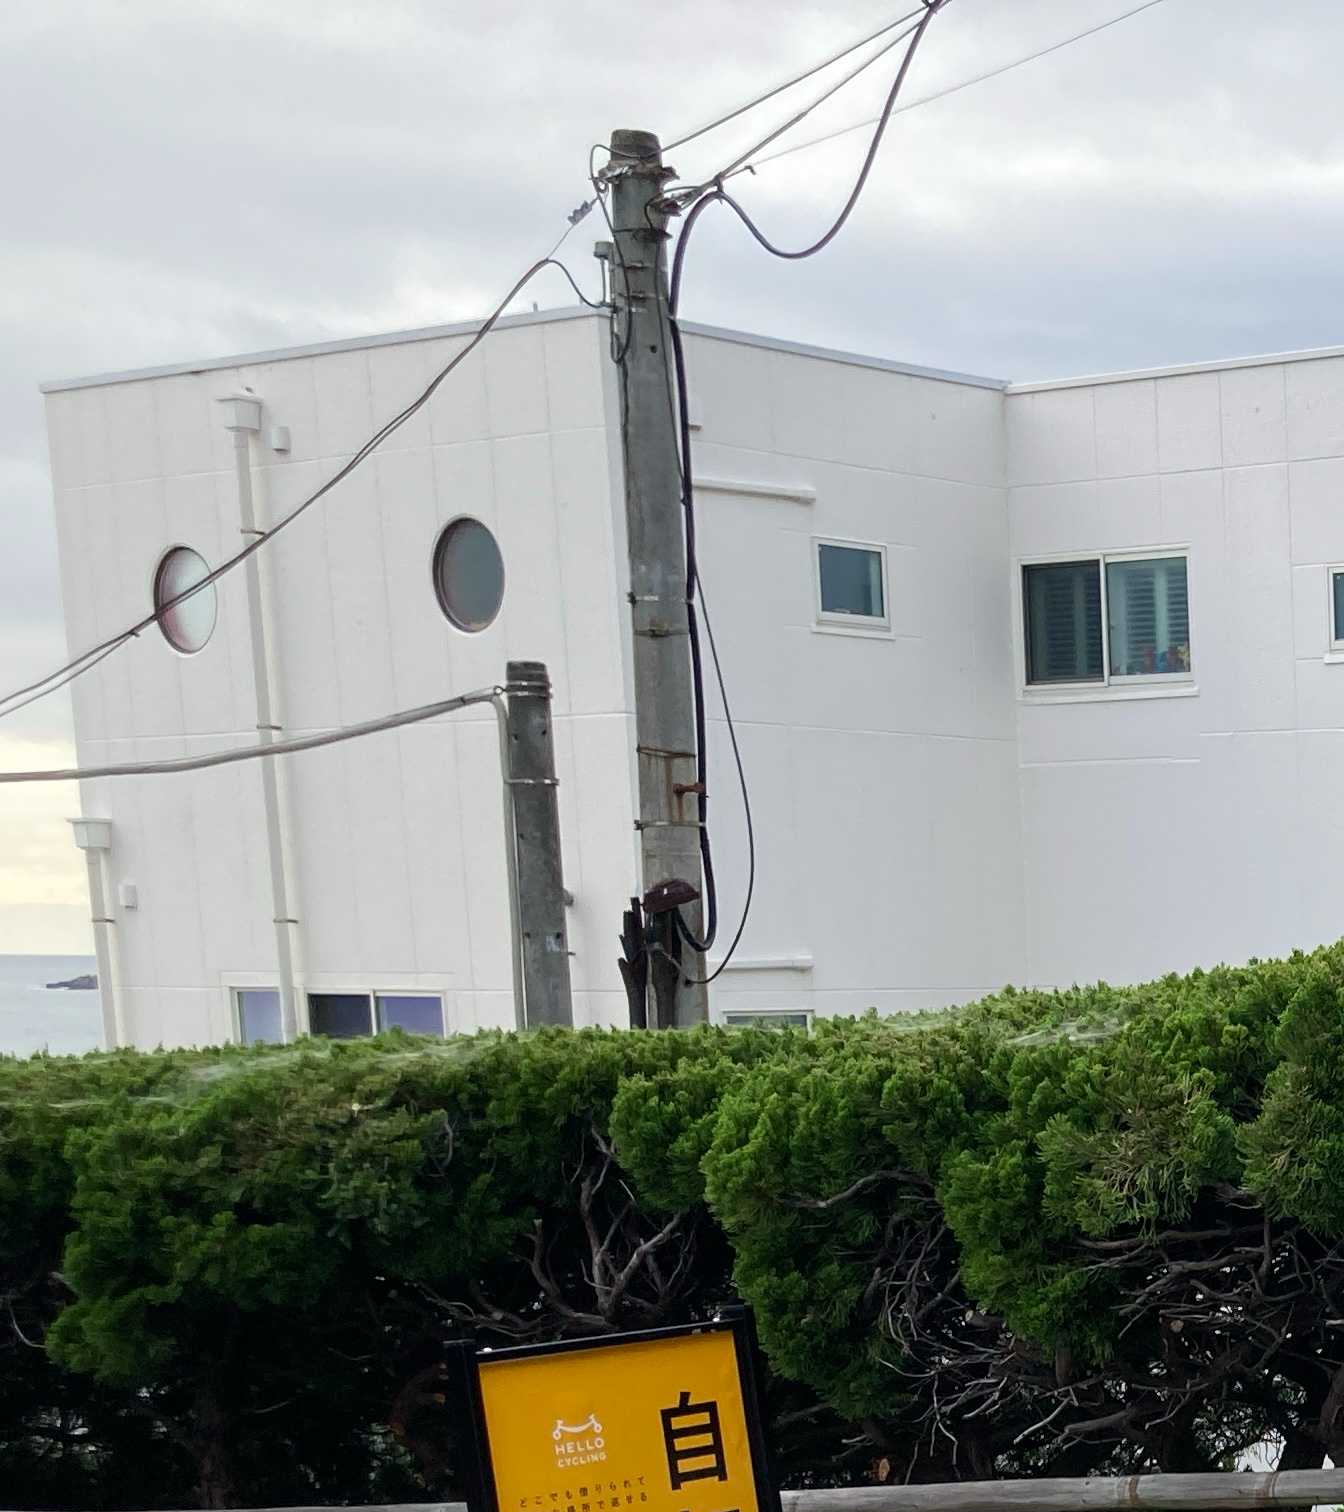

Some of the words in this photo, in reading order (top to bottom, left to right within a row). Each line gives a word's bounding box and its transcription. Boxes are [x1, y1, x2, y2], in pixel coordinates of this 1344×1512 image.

[554, 1437, 605, 1455] HELLO
[557, 1452, 607, 1468] CYCLING
[520, 1476, 646, 1508] どこでも借りられて
